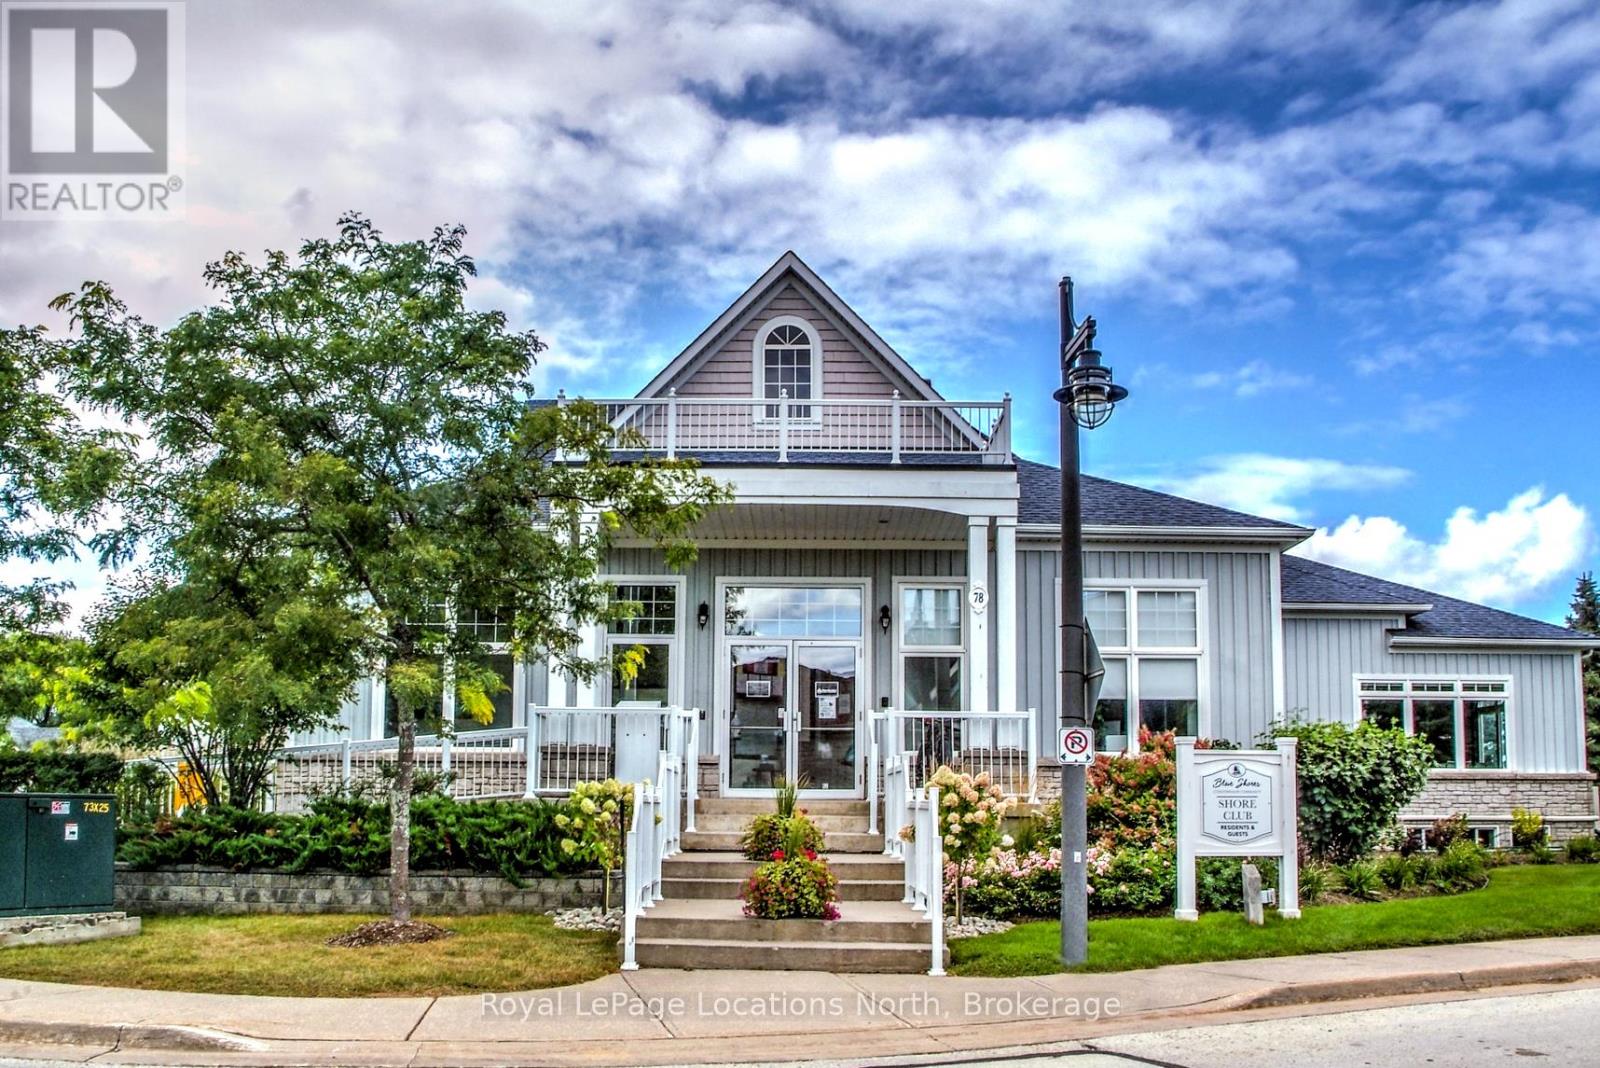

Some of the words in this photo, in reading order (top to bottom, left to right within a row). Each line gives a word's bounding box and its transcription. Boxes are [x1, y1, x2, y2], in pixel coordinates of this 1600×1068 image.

[974, 592, 984, 603] 78
[1212, 777, 1233, 788] Blue
[1235, 777, 1260, 788] Shores
[83, 802, 109, 813] 73X25
[1218, 799, 1257, 808] SHORE
[1223, 811, 1252, 820] CLUB
